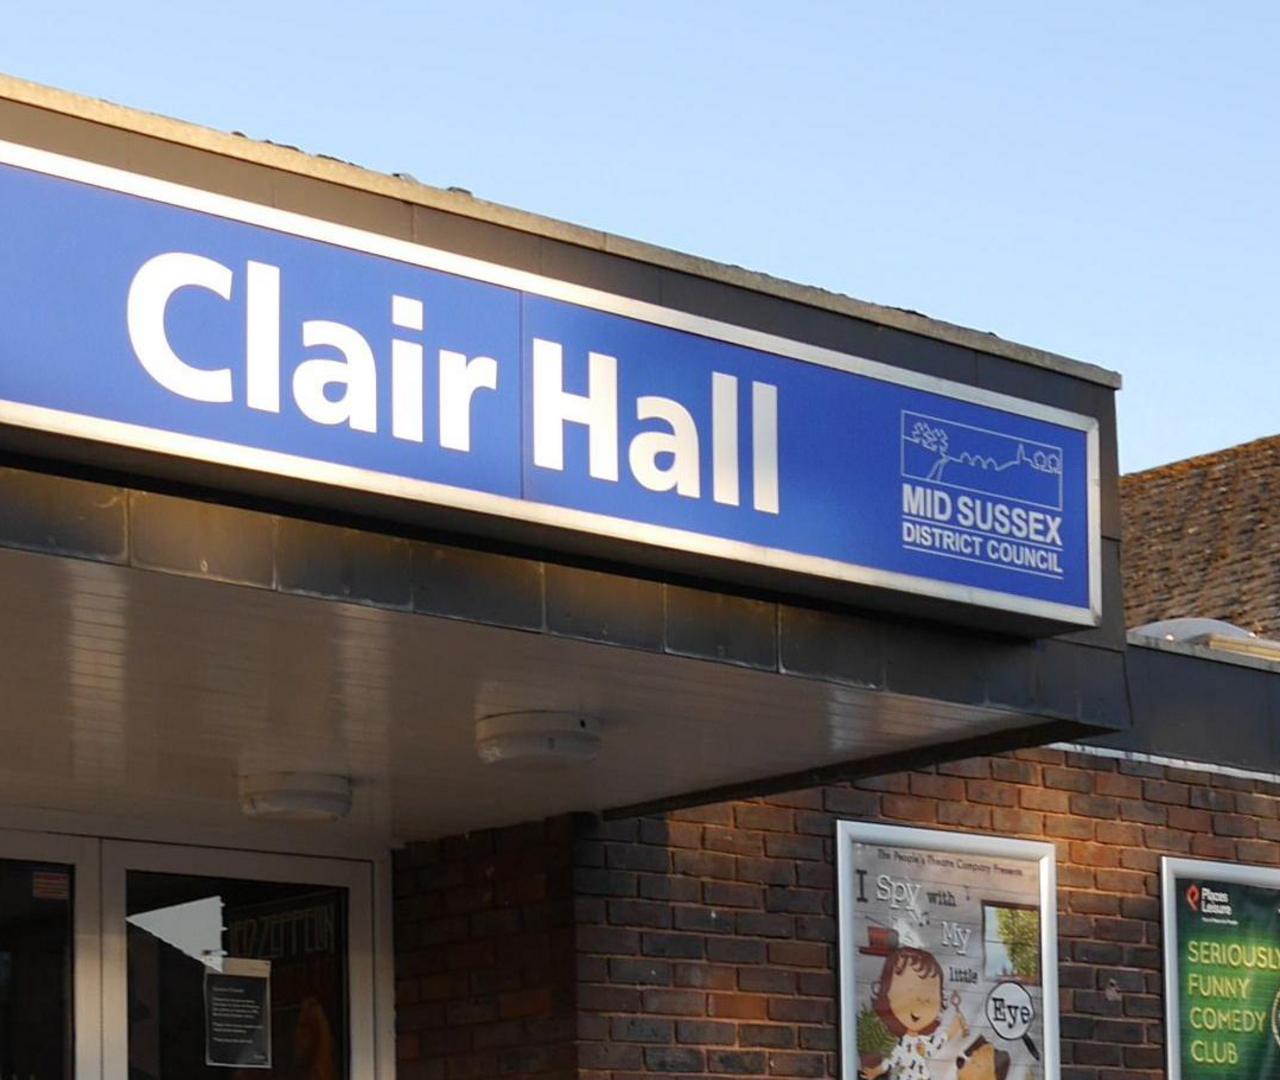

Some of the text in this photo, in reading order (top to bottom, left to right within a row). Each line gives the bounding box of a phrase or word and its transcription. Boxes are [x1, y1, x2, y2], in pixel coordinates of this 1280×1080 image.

[127, 251, 780, 515] Clair Hall
[902, 482, 1062, 547] MID SUSSEX
[902, 525, 1063, 574] DISTRICT COUNCIL
[855, 869, 958, 912] I Spy with
[940, 920, 973, 957] My
[949, 966, 979, 984] little
[1188, 973, 1250, 999] FUNNY
[991, 998, 1031, 1029] Eye
[1189, 1007, 1267, 1033] COMEDY
[1190, 1040, 1239, 1065] CLUB
